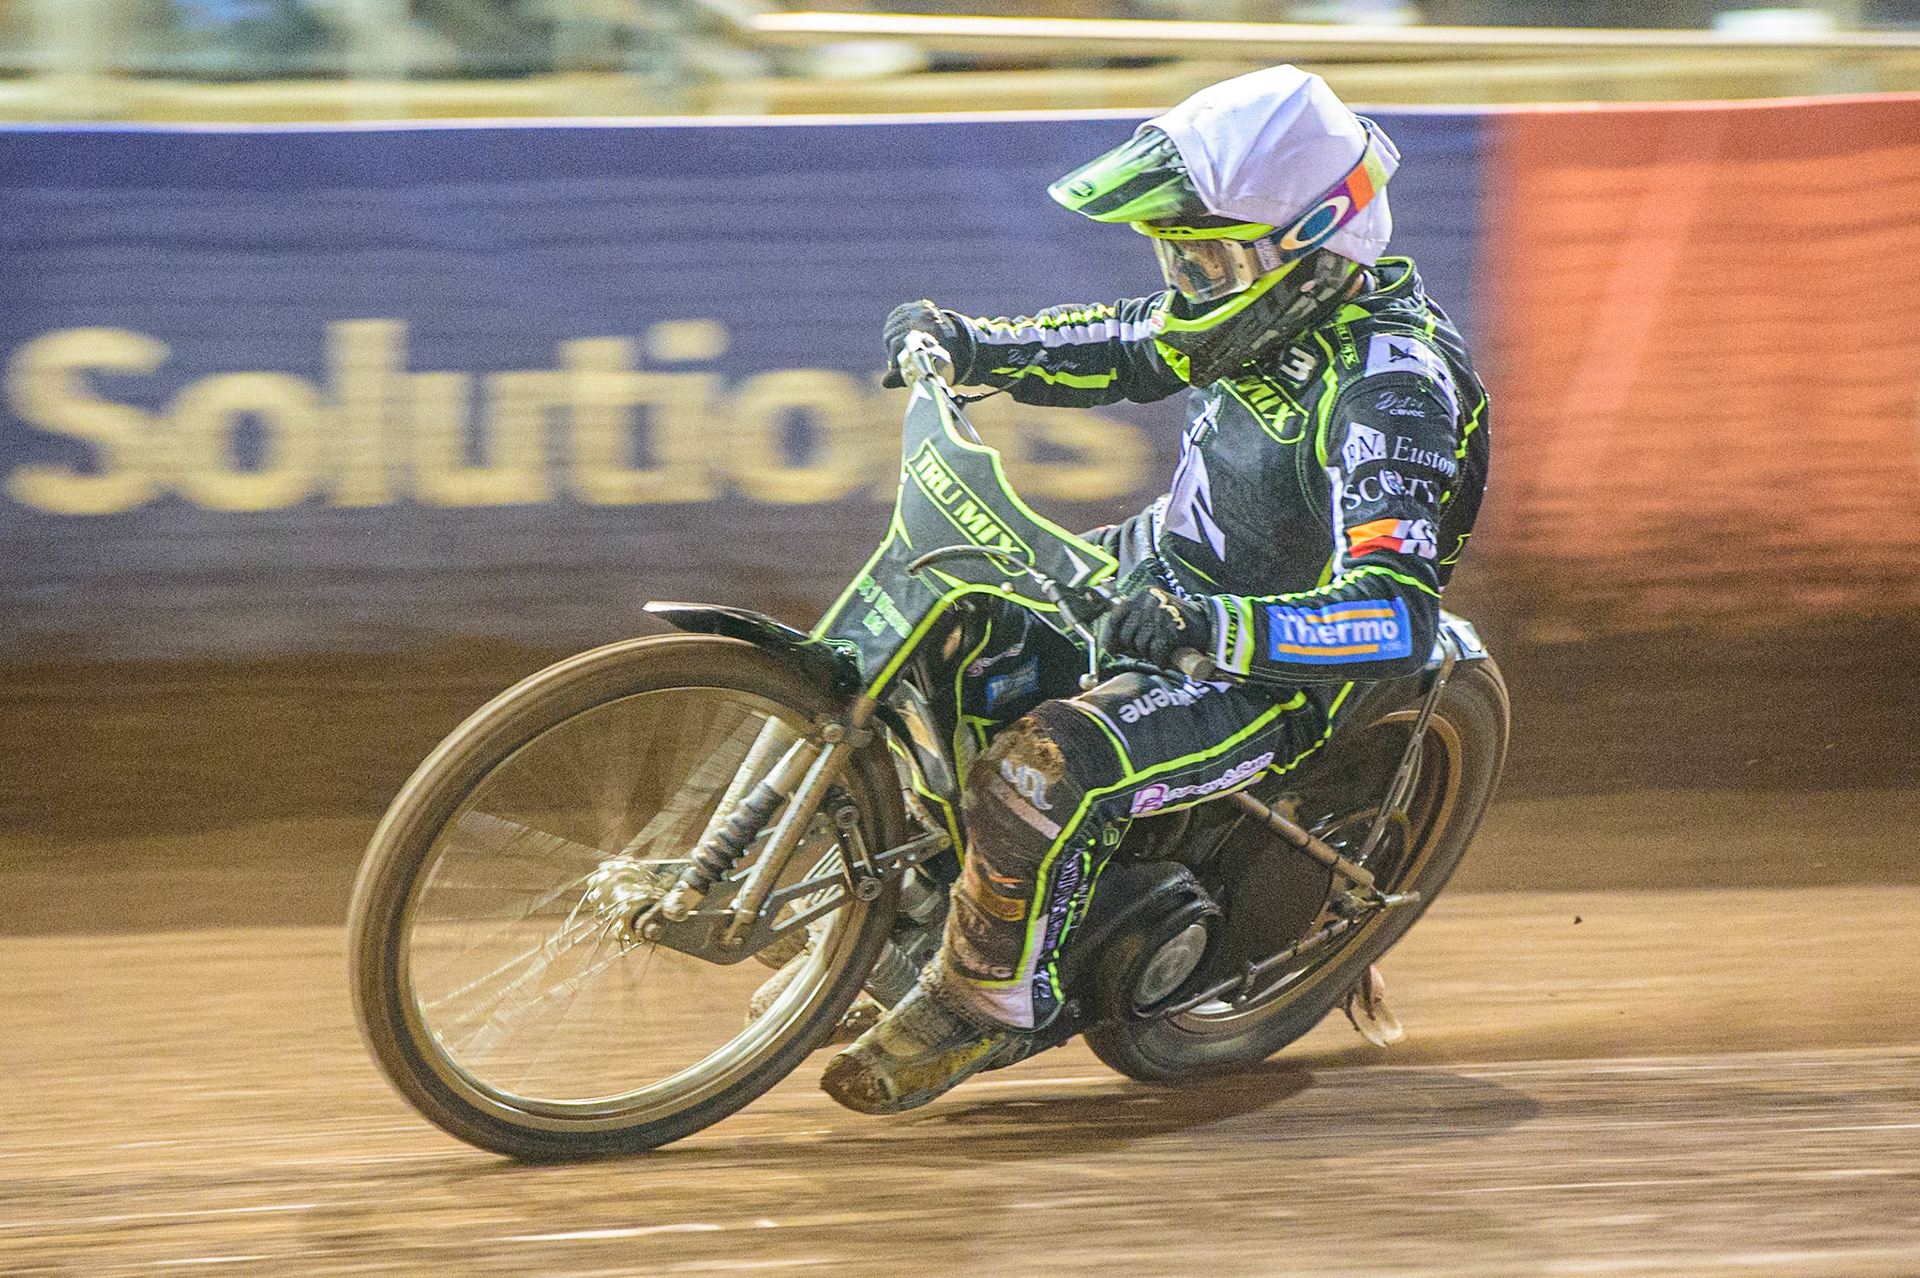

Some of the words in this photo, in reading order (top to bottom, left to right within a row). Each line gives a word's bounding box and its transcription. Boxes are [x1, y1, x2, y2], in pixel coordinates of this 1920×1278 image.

[6, 317, 1152, 515] Solutios
[1392, 435, 1457, 477] Euston
[915, 450, 963, 505] TRU
[953, 498, 1022, 564] MIX
[1277, 613, 1399, 645] Thermo
